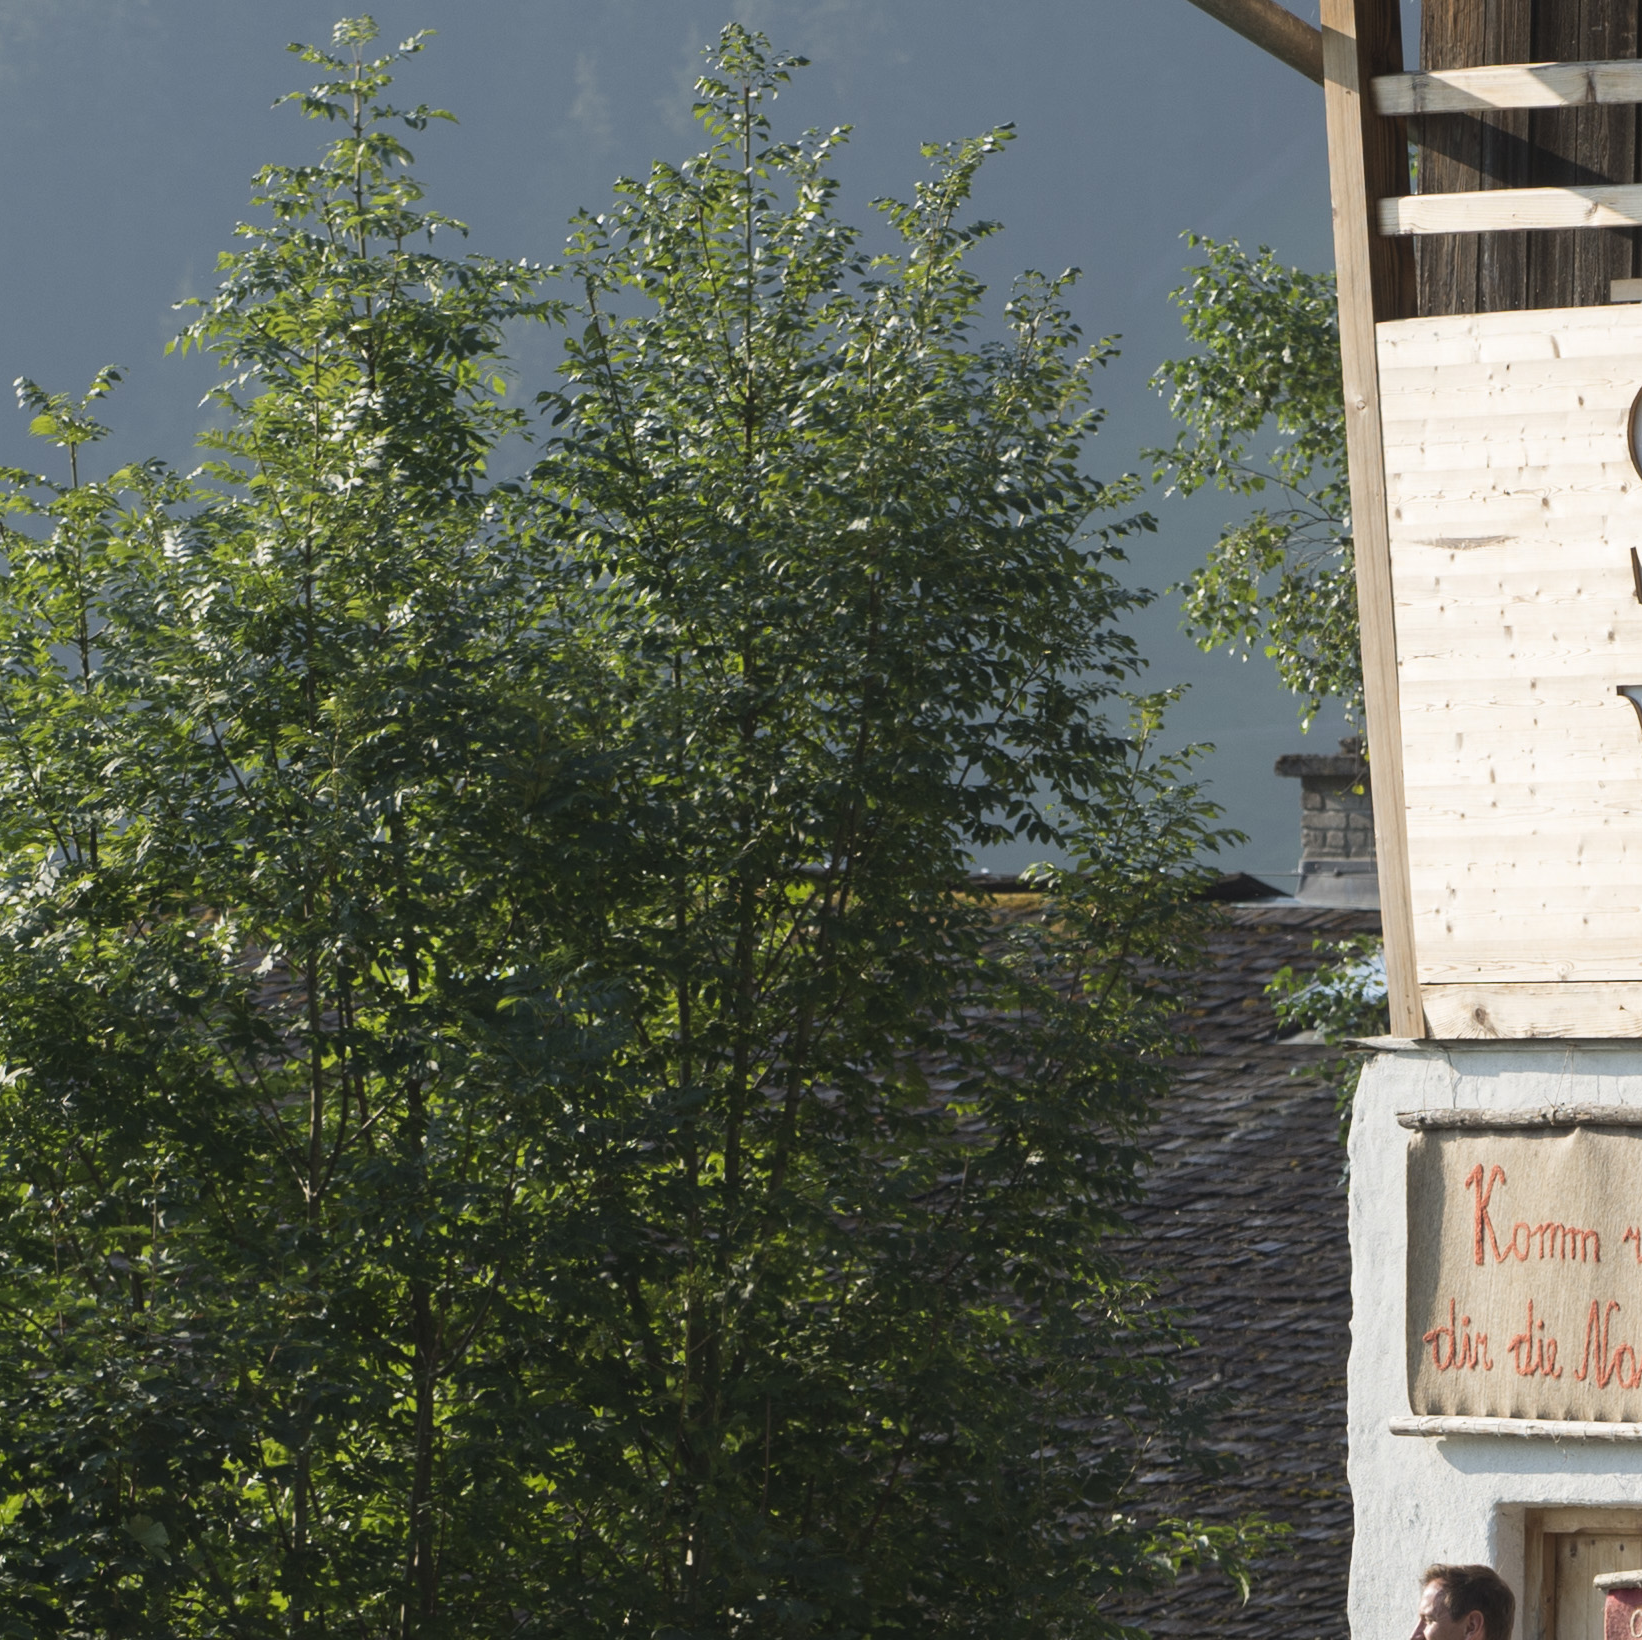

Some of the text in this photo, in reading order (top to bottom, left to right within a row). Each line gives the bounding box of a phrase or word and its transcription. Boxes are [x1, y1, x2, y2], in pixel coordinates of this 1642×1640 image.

[1465, 1164, 1600, 1265] Komm
[1423, 1299, 1493, 1371] dir
[1508, 1299, 1562, 1378] die
